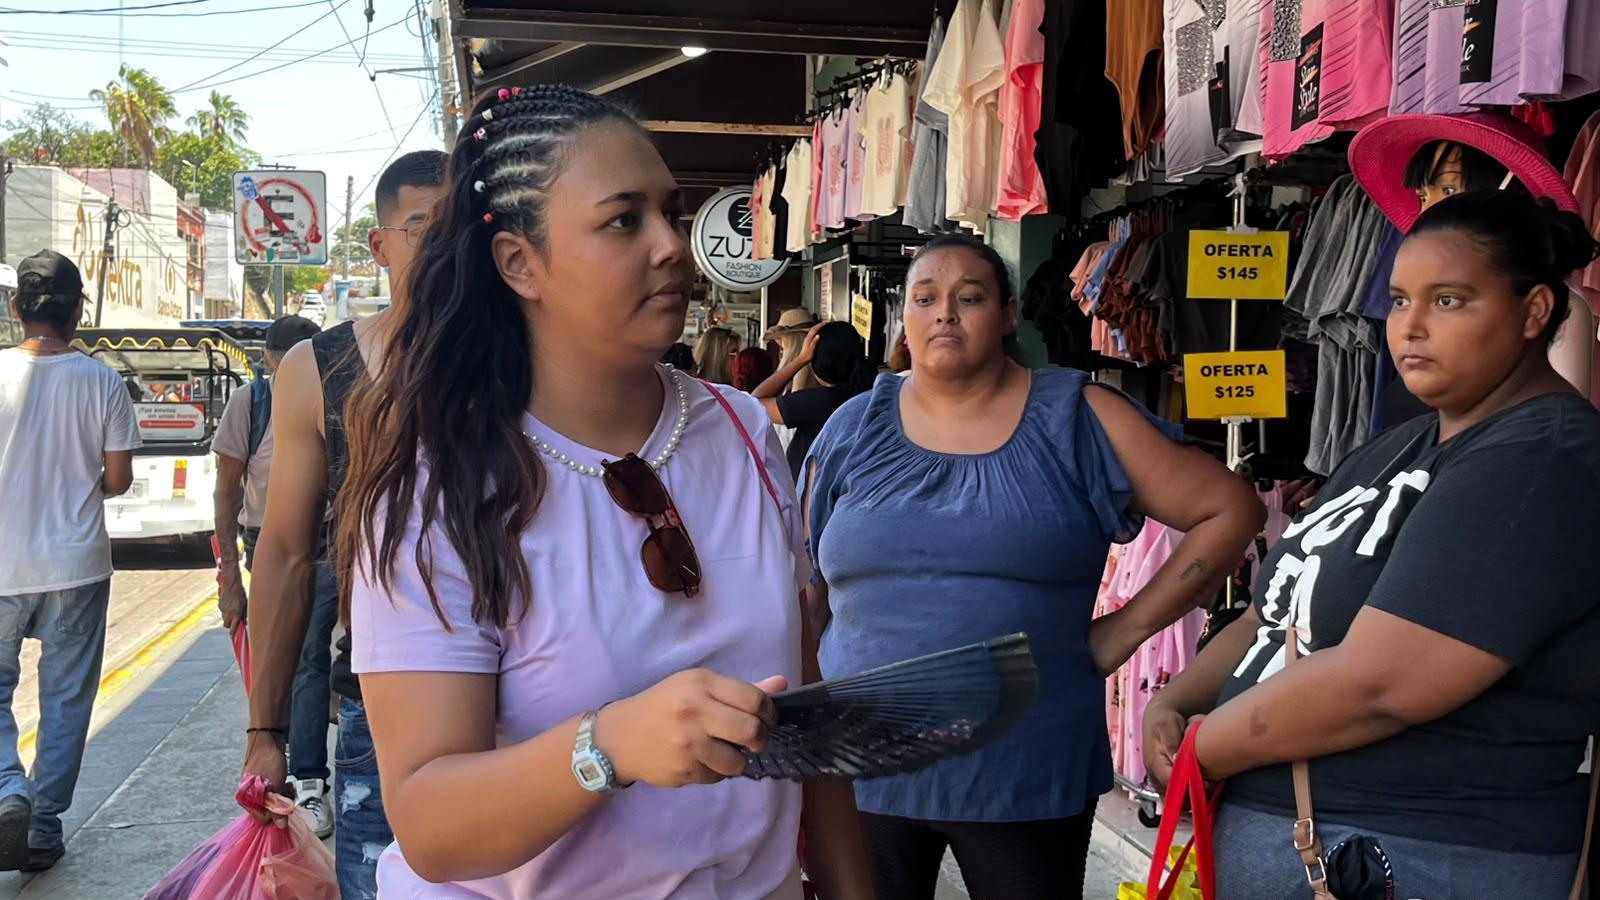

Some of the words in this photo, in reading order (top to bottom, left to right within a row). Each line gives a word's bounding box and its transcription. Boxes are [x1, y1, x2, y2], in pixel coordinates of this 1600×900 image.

[263, 195, 294, 237] E
[1204, 243, 1273, 257] OFERTA
[726, 262, 762, 271] FASHION
[1217, 266, 1257, 280] $145
[726, 270, 761, 278] BOUTIQUE
[1200, 363, 1268, 377] OFERTA
[1215, 385, 1254, 399] $125
